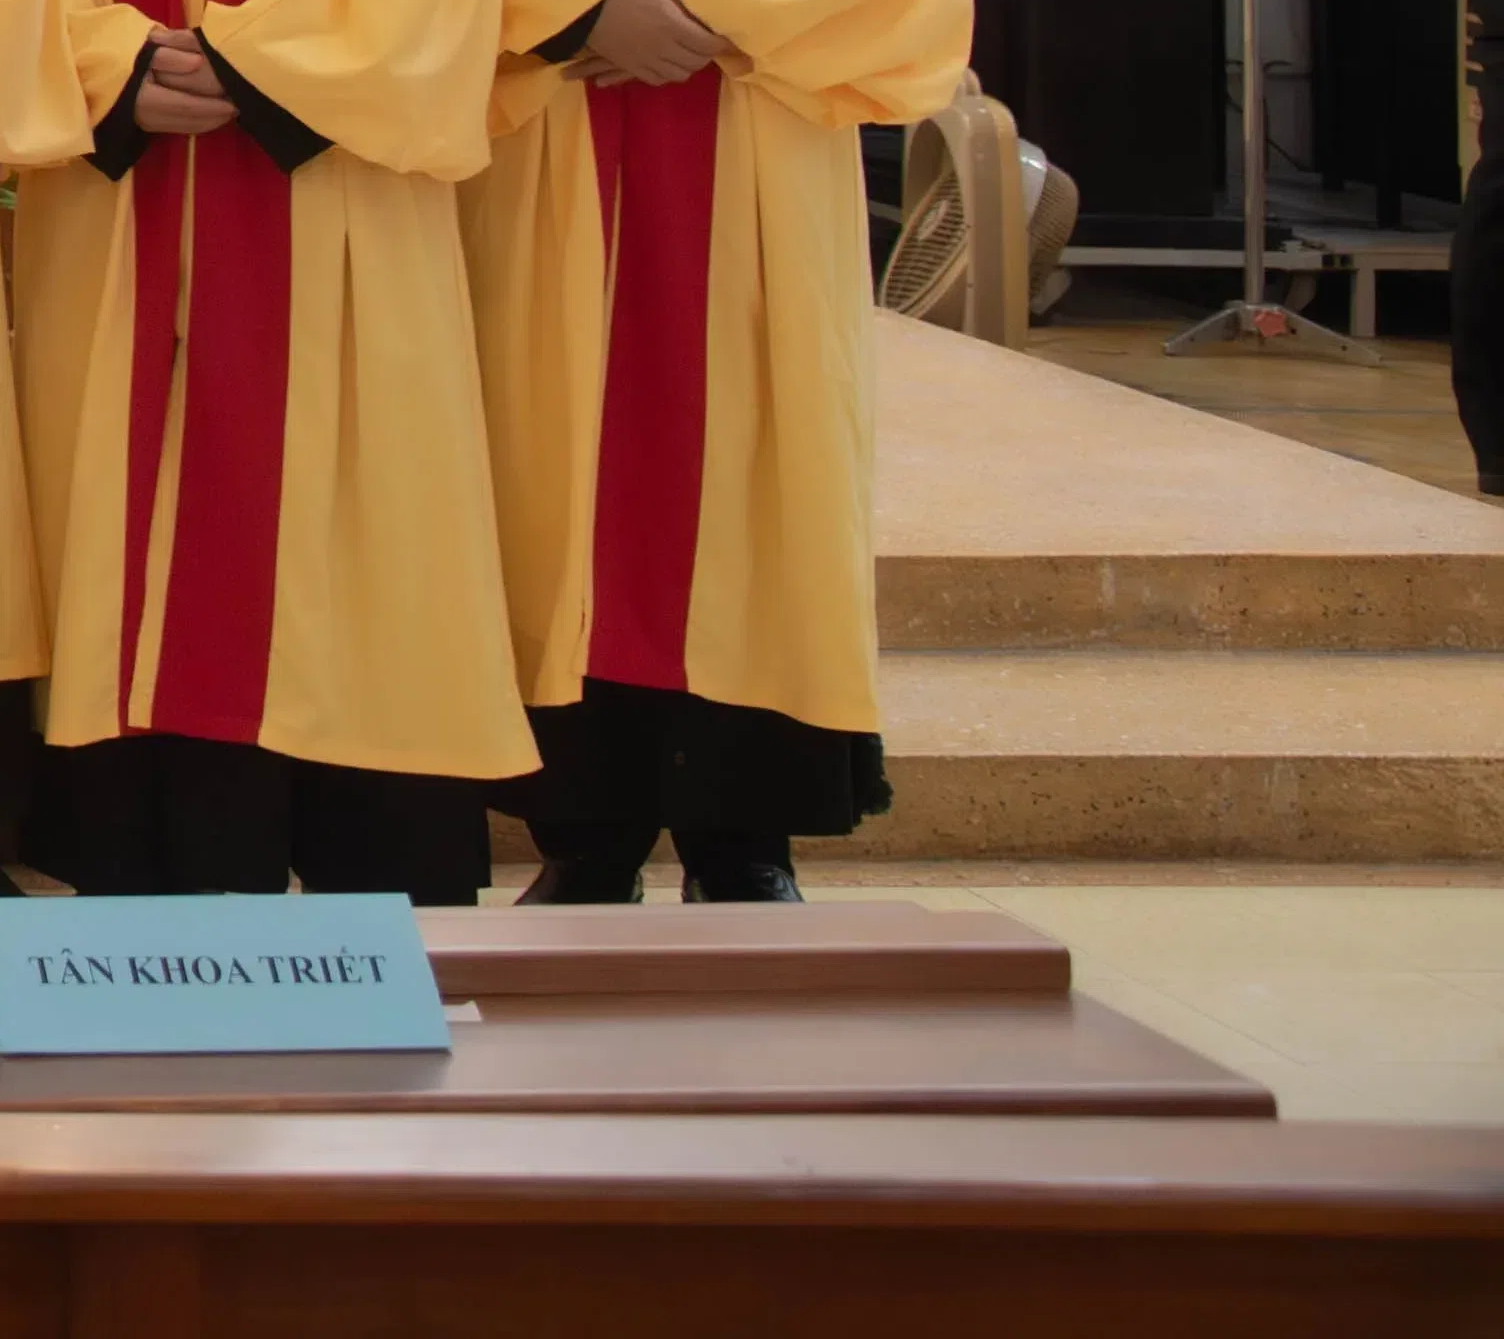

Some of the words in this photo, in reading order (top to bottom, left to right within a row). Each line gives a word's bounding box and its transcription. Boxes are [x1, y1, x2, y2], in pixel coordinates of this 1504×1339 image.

[28, 947, 116, 985] TÂN
[127, 955, 256, 985] KHOA
[257, 945, 386, 985] TRIẾT
